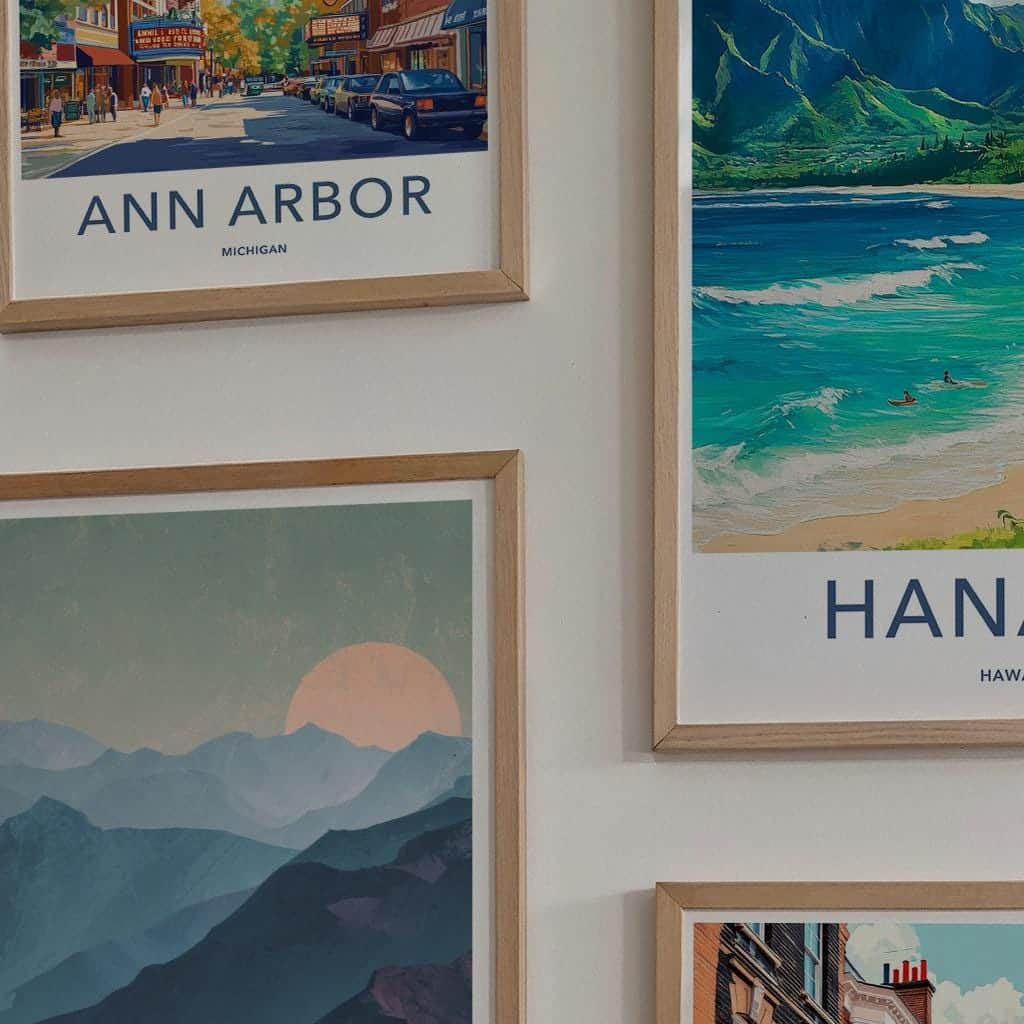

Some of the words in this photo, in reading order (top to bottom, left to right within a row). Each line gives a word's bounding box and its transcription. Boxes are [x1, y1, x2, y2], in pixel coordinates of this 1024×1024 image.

[77, 188, 205, 236] ANN
[228, 175, 432, 227] ARBOR
[221, 243, 288, 257] MICHIGAN
[826, 577, 1024, 640] HAN
[980, 668, 1024, 682] HAW
